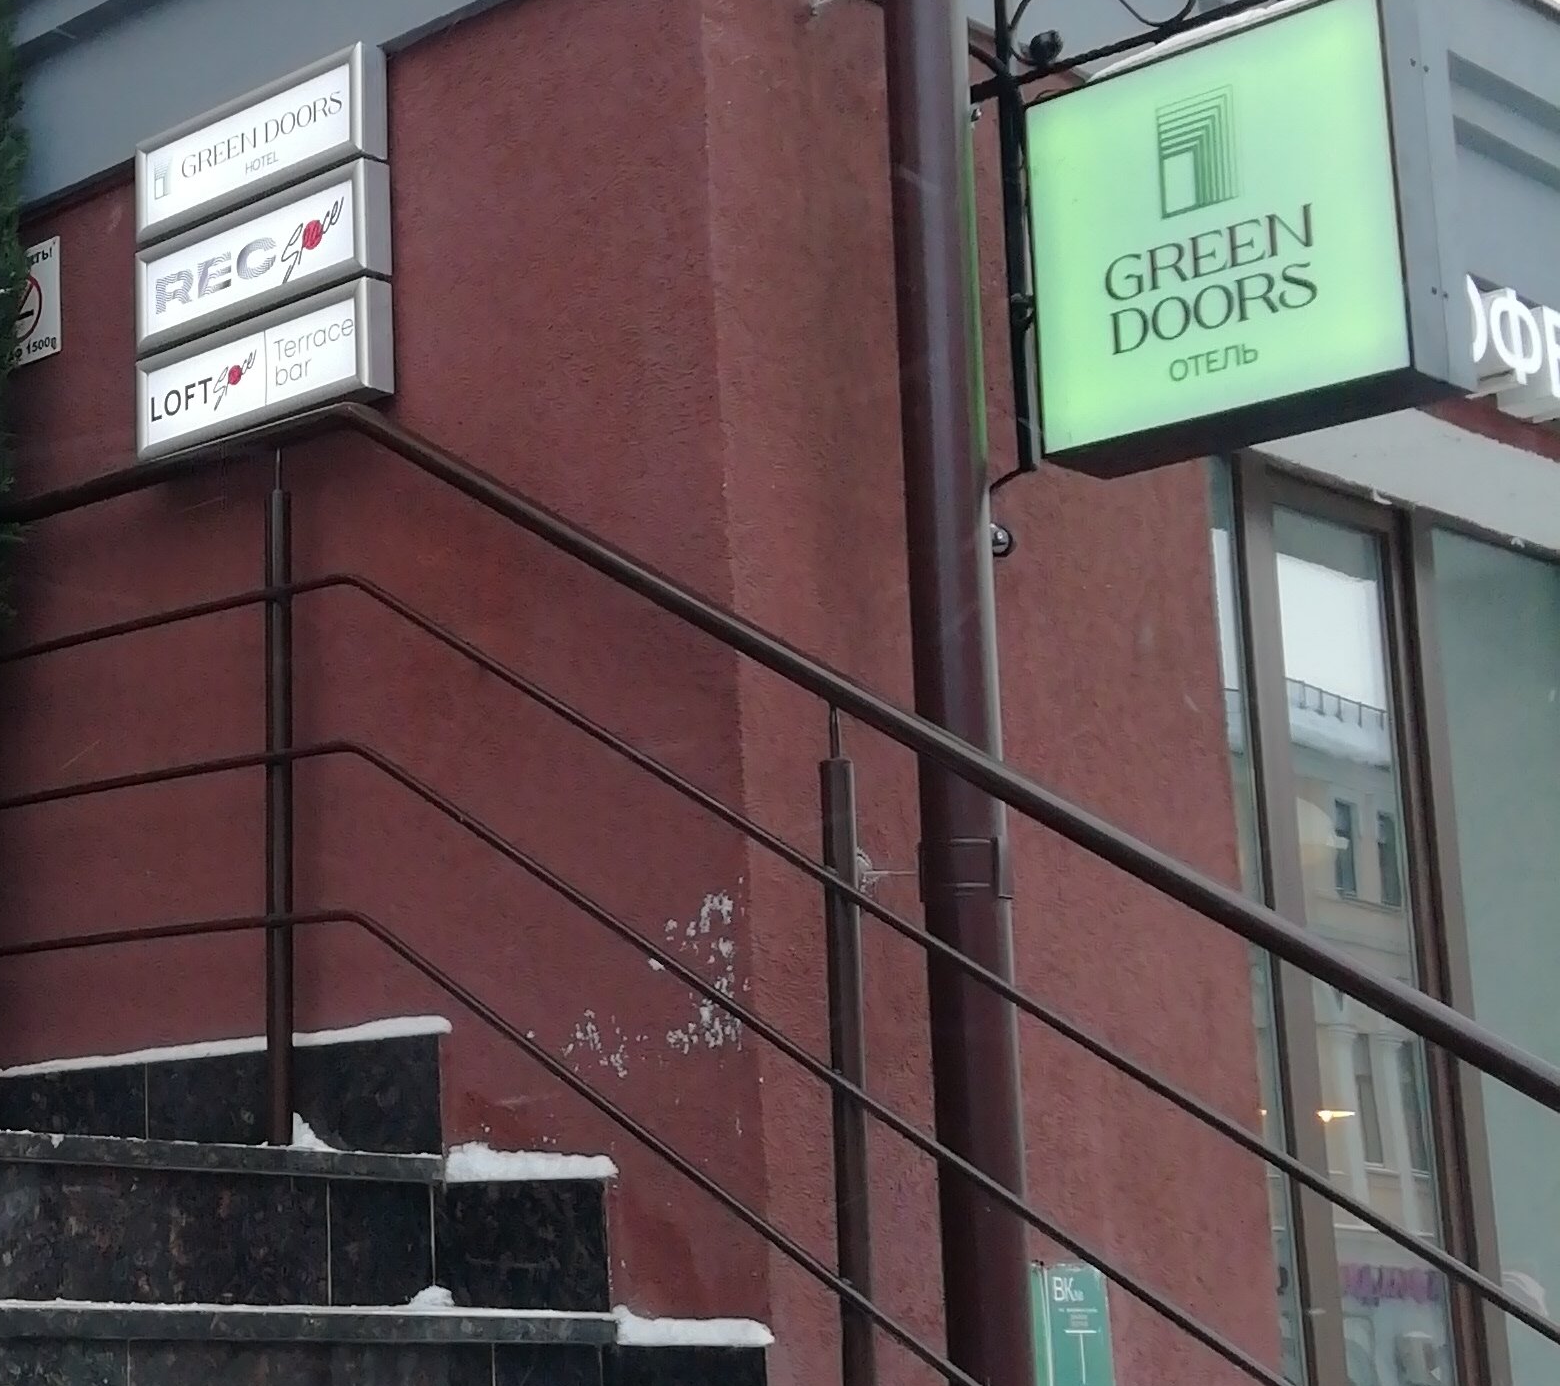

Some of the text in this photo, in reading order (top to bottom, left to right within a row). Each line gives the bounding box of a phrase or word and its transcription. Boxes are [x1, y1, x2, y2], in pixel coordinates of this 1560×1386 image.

[180, 90, 343, 179] GREEN DOORS
[244, 151, 280, 176] HOTEL
[155, 195, 345, 315] REC Space
[1104, 202, 1315, 302] GREEN
[273, 317, 355, 362] Terrace
[1109, 261, 1320, 356] DOORS
[150, 348, 258, 423] LOFT Space
[274, 357, 313, 387] bar
[1167, 342, 1260, 383] ОТЕЛЬ
